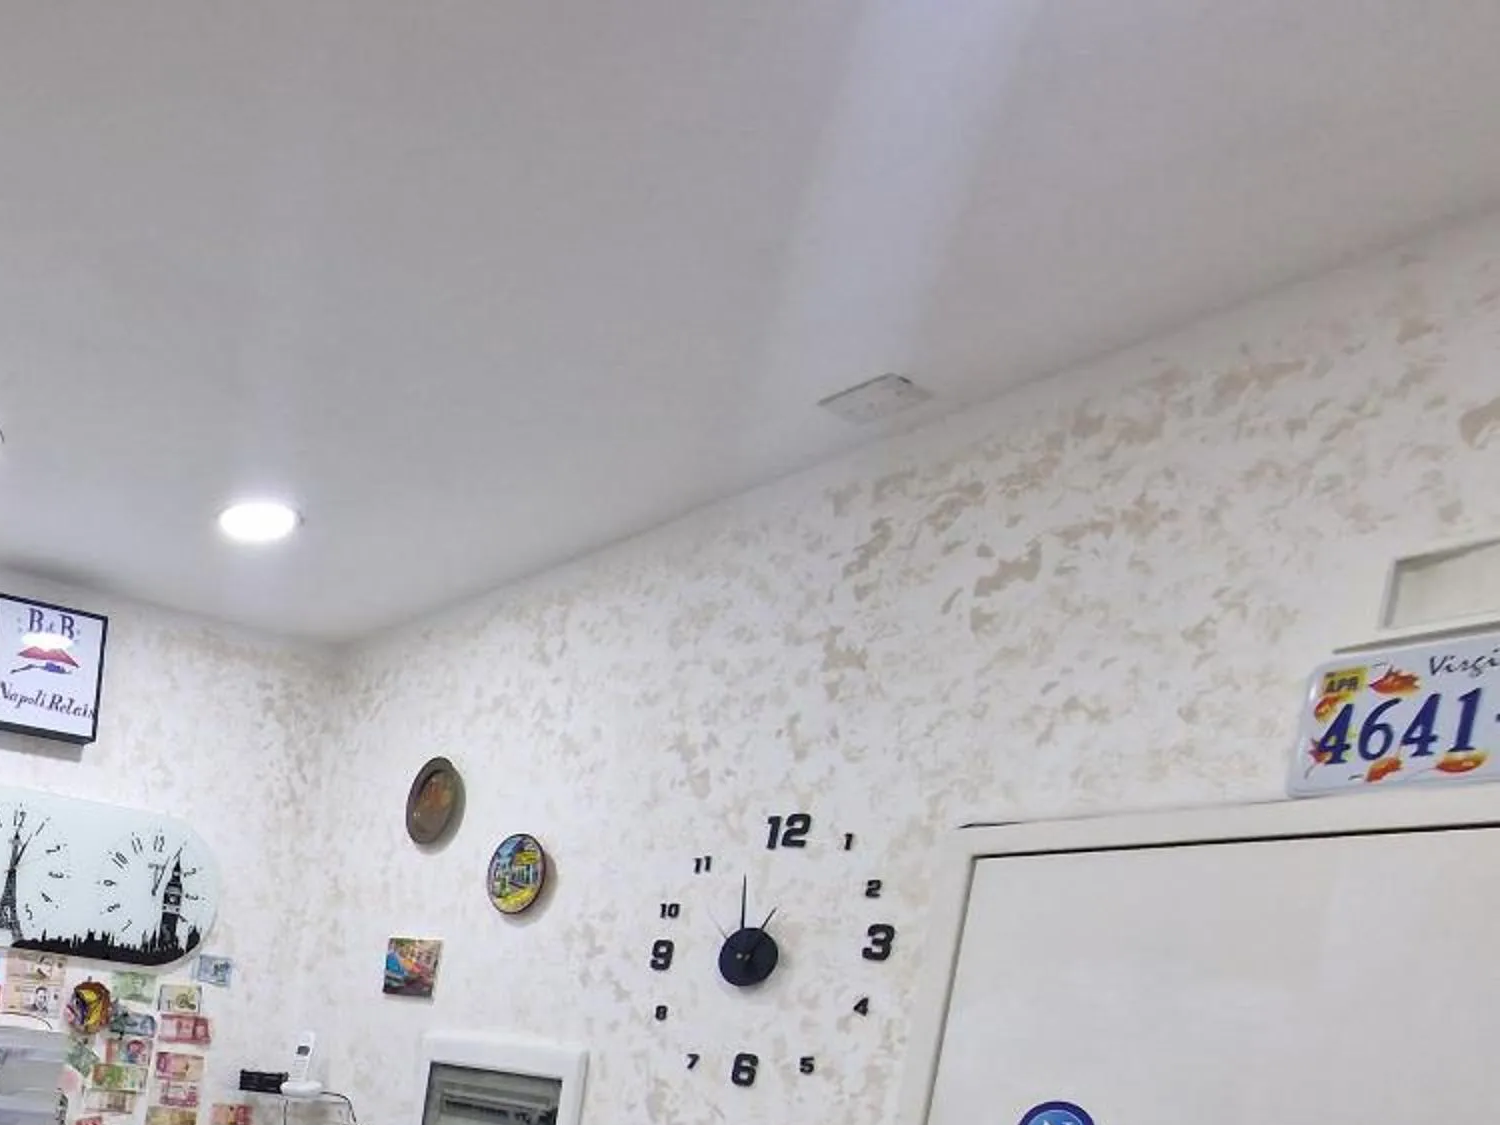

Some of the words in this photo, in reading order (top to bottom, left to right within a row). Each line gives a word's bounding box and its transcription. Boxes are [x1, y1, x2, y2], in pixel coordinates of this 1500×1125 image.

[766, 813, 811, 850] 12
[843, 832, 855, 850] 1
[694, 856, 712, 874] 11
[865, 879, 882, 898] 2
[660, 903, 680, 918] 10
[861, 923, 896, 961] 3
[650, 939, 675, 970] 9
[655, 1005, 668, 1021] 8
[853, 997, 870, 1016] 4
[686, 1053, 700, 1069] 7
[731, 1052, 759, 1087] 6
[800, 1056, 815, 1075] 5
